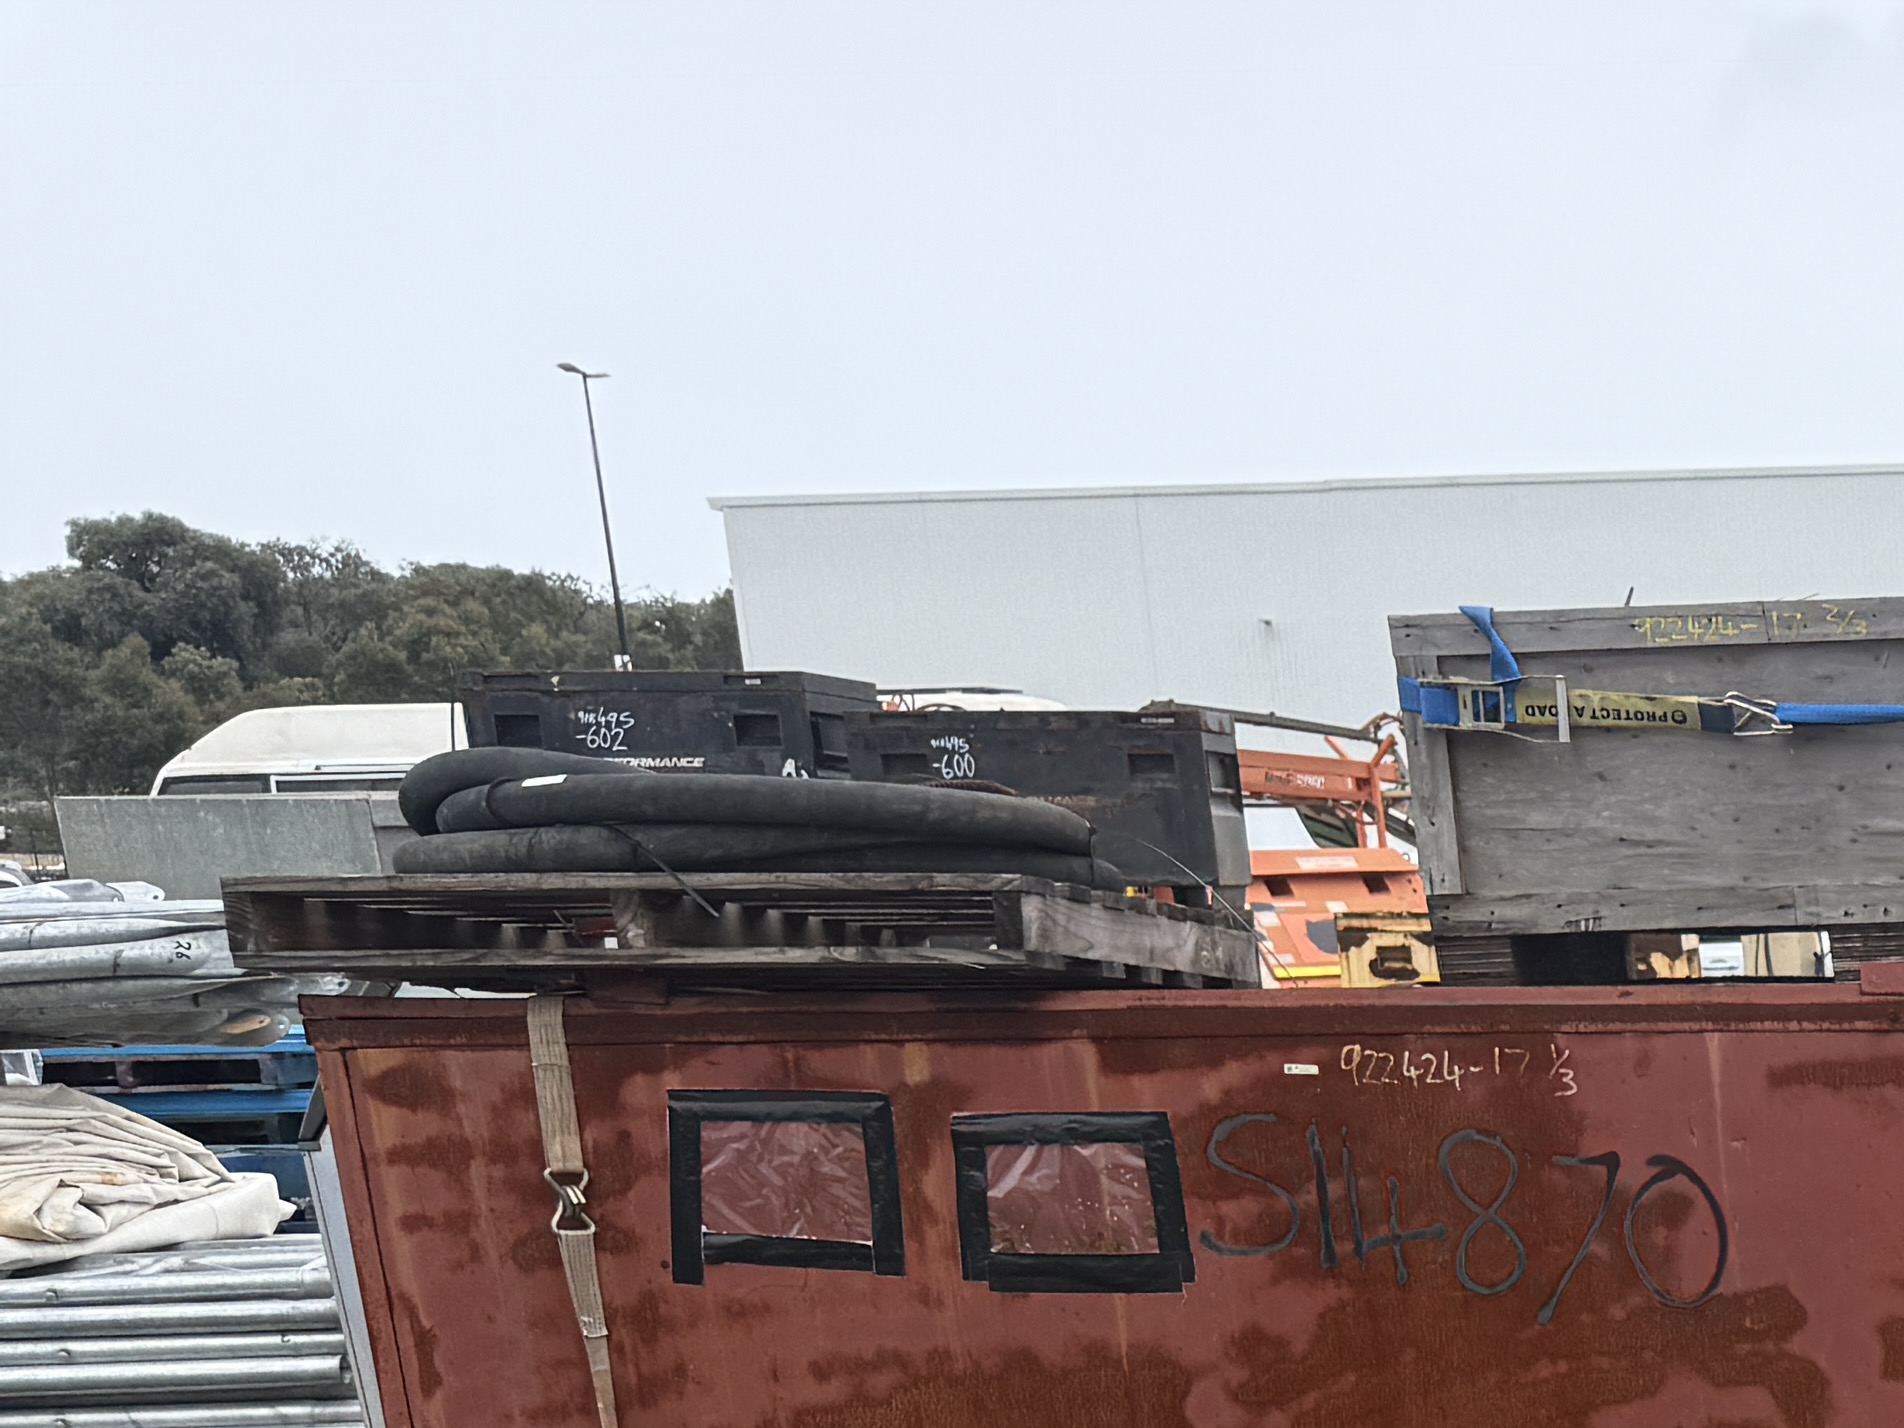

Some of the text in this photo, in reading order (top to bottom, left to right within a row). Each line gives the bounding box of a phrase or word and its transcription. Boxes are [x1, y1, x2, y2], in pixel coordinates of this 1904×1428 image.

[1525, 704, 1668, 723] PROTECT A OAD
[603, 757, 705, 768] ORMANCE
